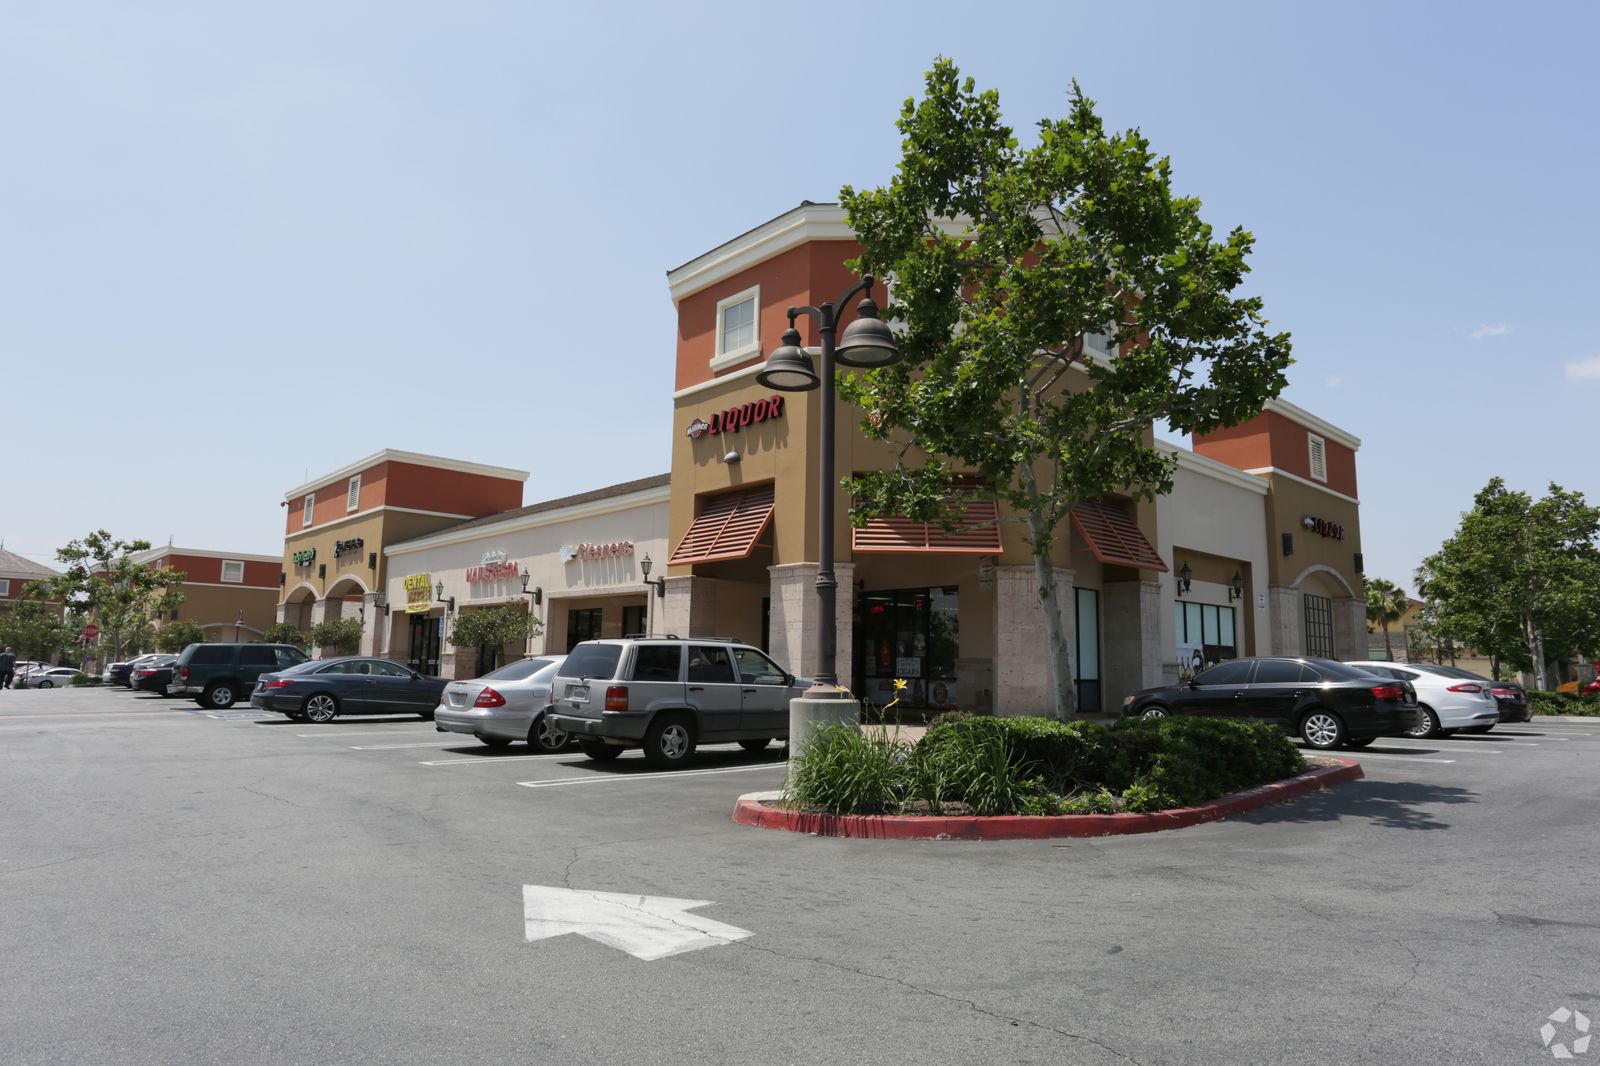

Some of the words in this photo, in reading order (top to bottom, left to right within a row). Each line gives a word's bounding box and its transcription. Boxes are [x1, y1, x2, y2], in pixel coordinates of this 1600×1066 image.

[709, 394, 783, 435] LIQUOR
[576, 541, 633, 561] Cleaners
[403, 573, 430, 590] DENTAL
[466, 566, 491, 582] NAILS
[502, 561, 519, 578] SPA
